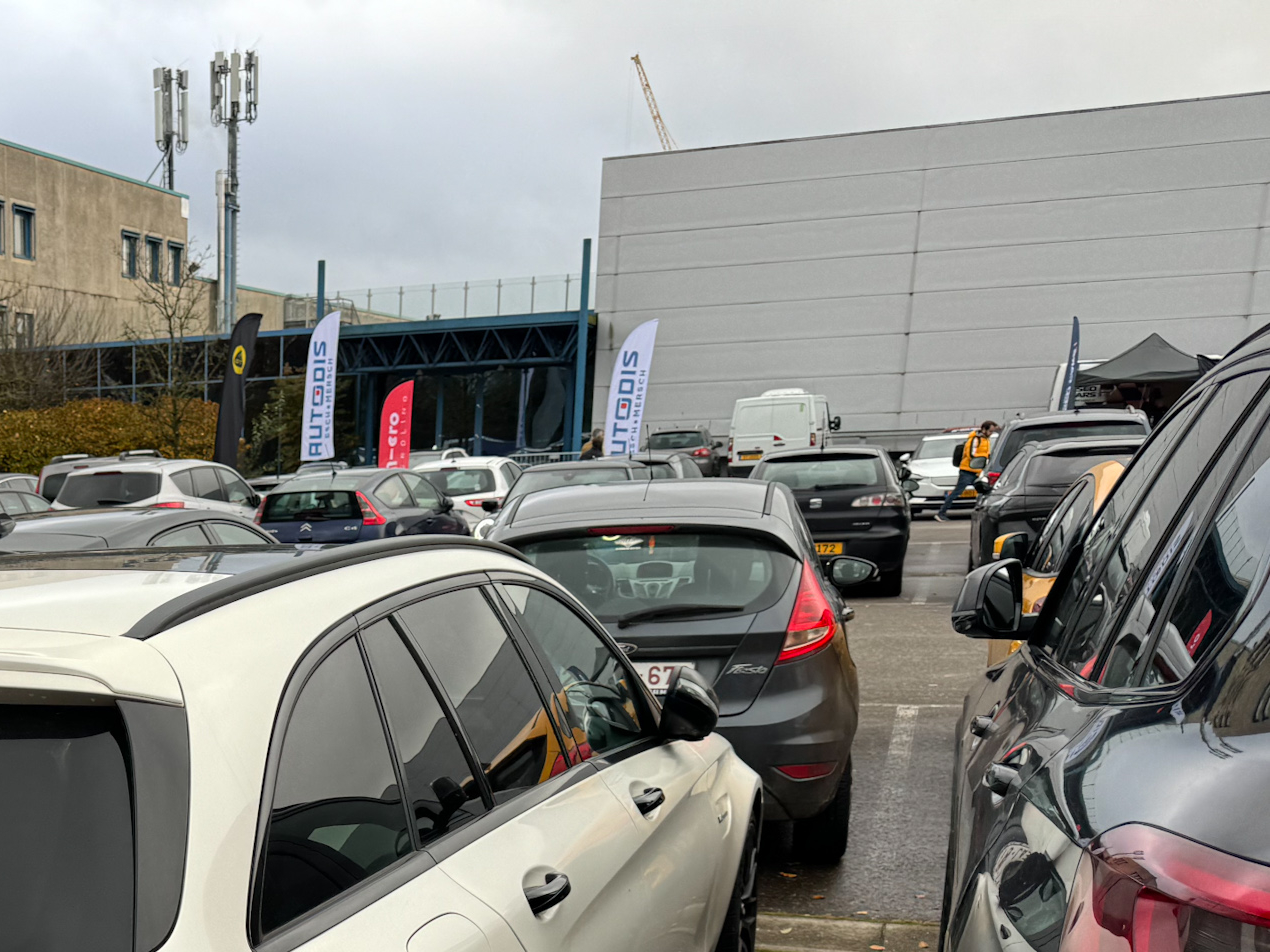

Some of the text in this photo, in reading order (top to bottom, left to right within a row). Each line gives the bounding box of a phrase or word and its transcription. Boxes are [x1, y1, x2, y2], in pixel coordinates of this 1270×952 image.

[308, 341, 327, 457] AUTODIS
[611, 350, 639, 455] UTODIS
[633, 369, 646, 418] MERSCH
[726, 663, 769, 675] Fiesta
